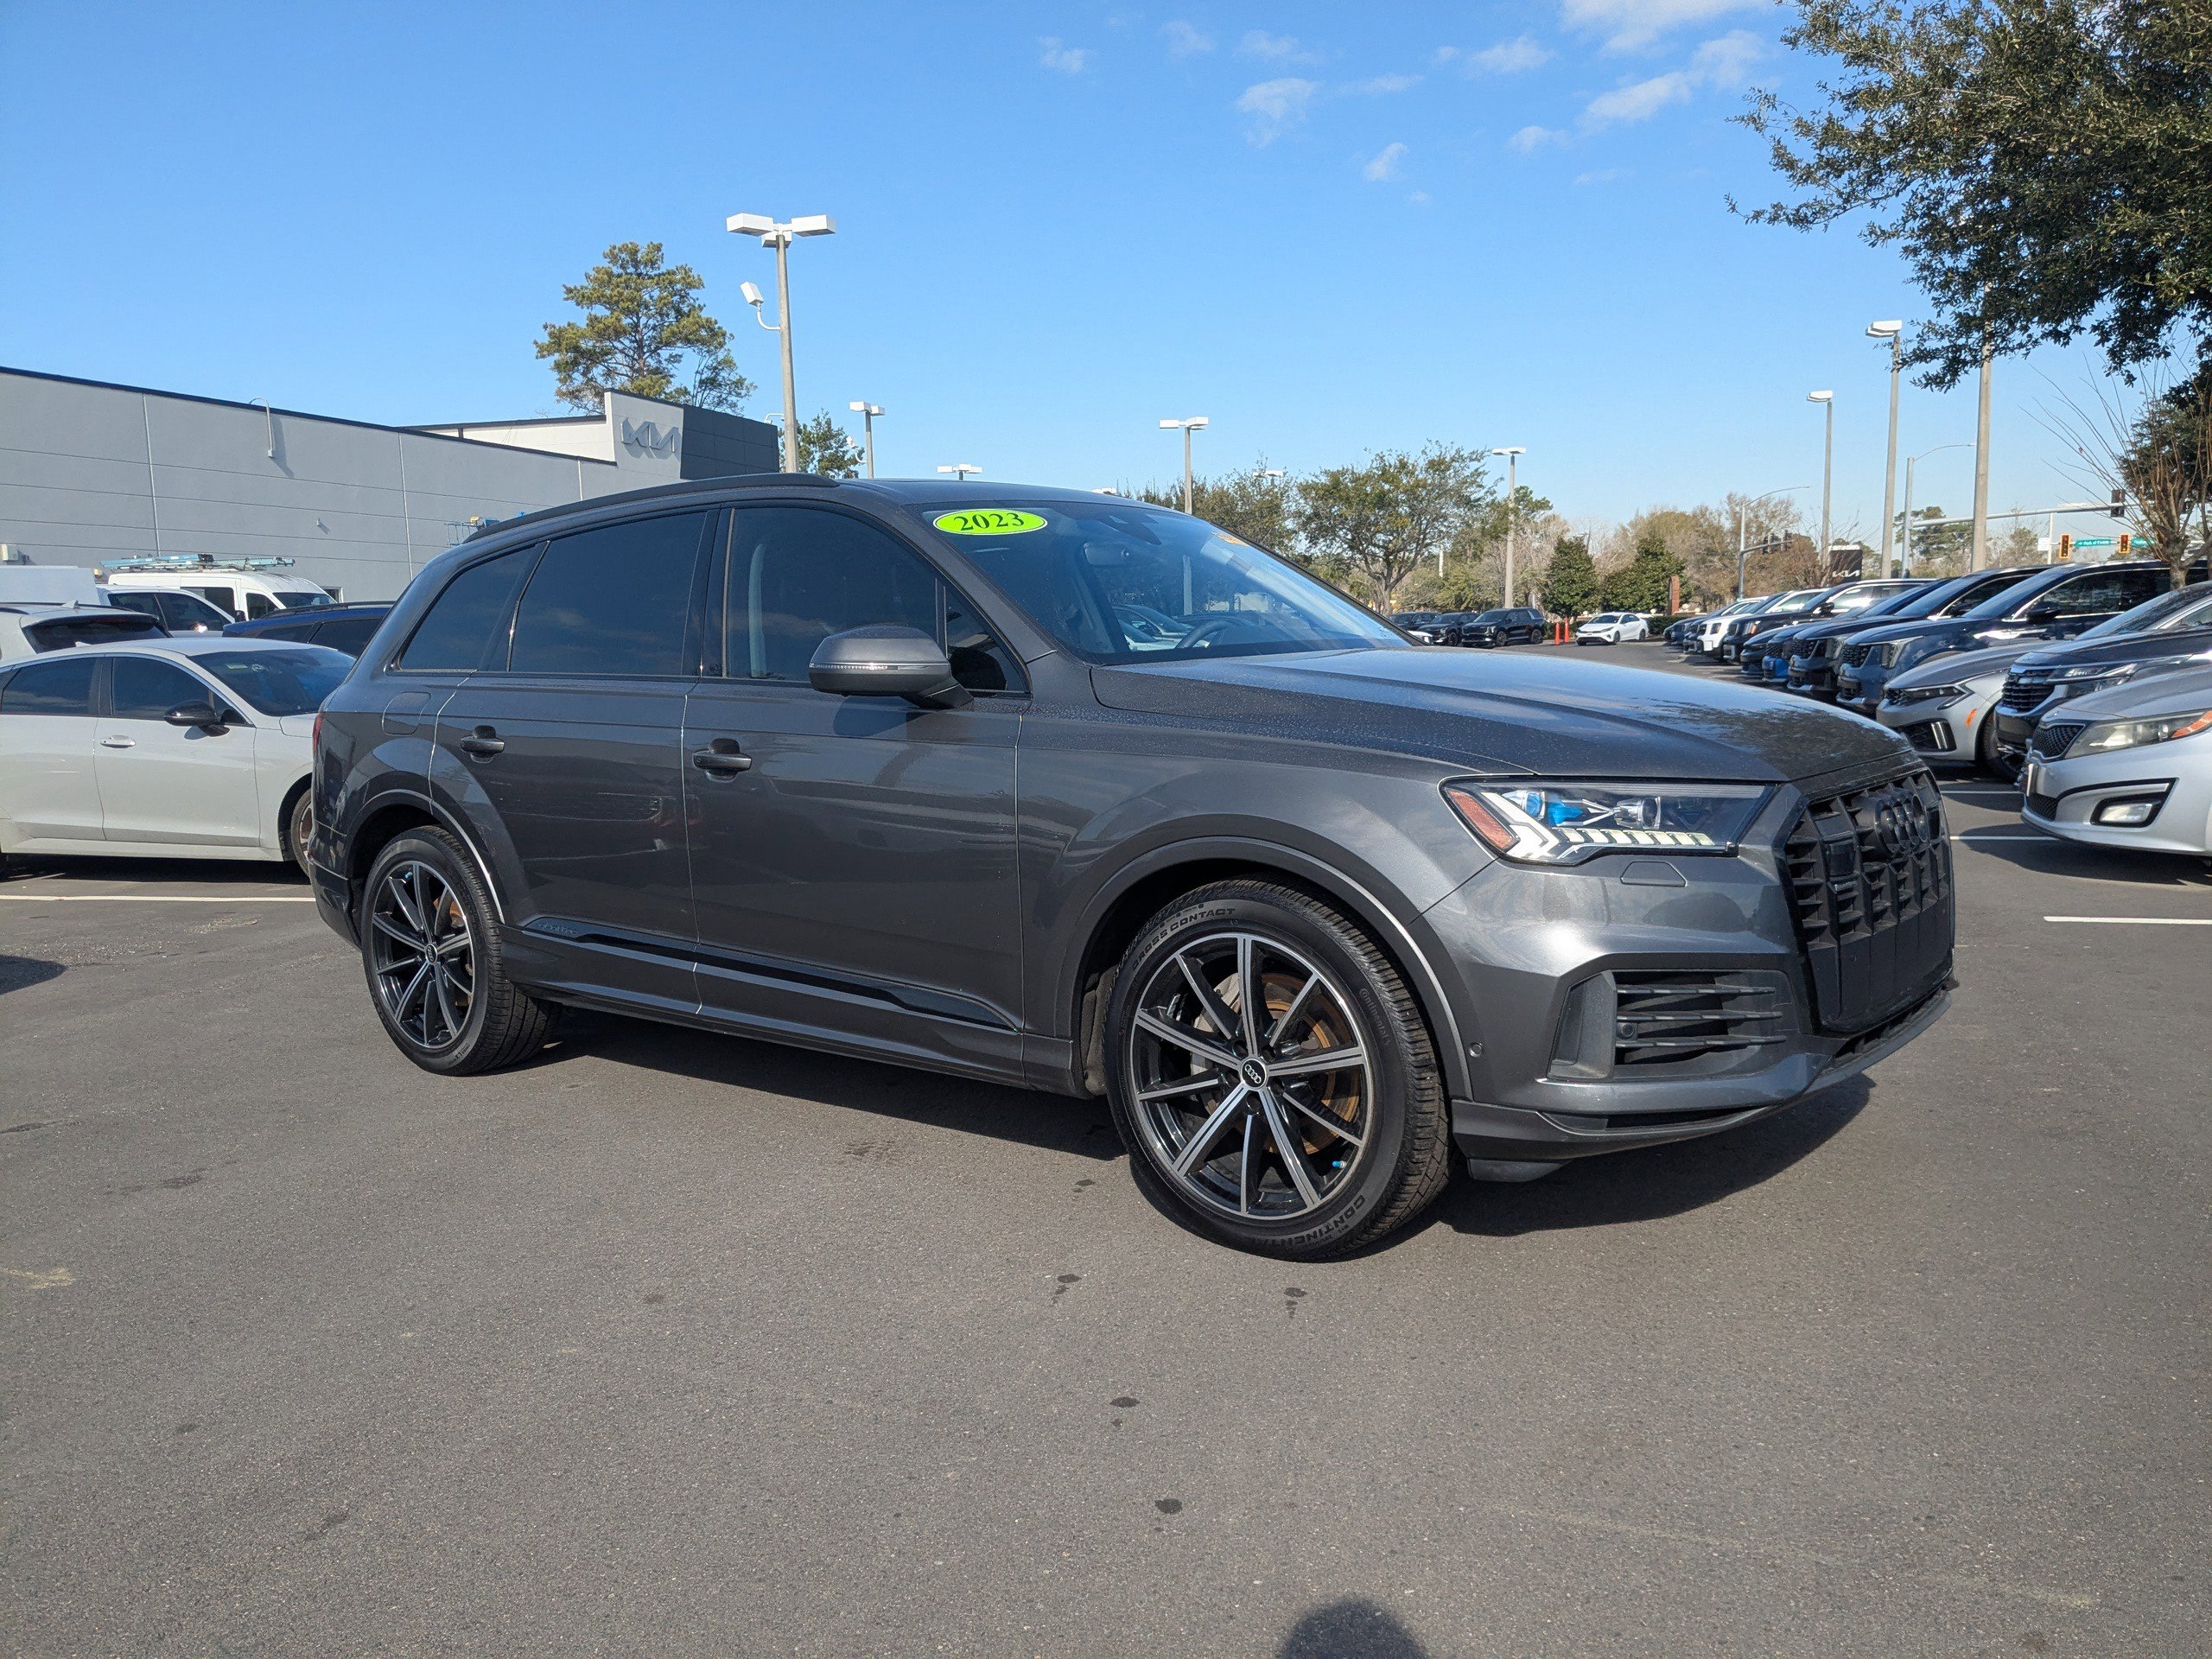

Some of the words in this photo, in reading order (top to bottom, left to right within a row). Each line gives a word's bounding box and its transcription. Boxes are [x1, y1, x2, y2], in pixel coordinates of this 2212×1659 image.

[620, 416, 681, 453] KIA
[953, 512, 1025, 531] 2023
[1132, 929, 1168, 970] CROSS
[1170, 908, 1236, 932] CONTACT
[1359, 988, 1389, 1039] Continental
